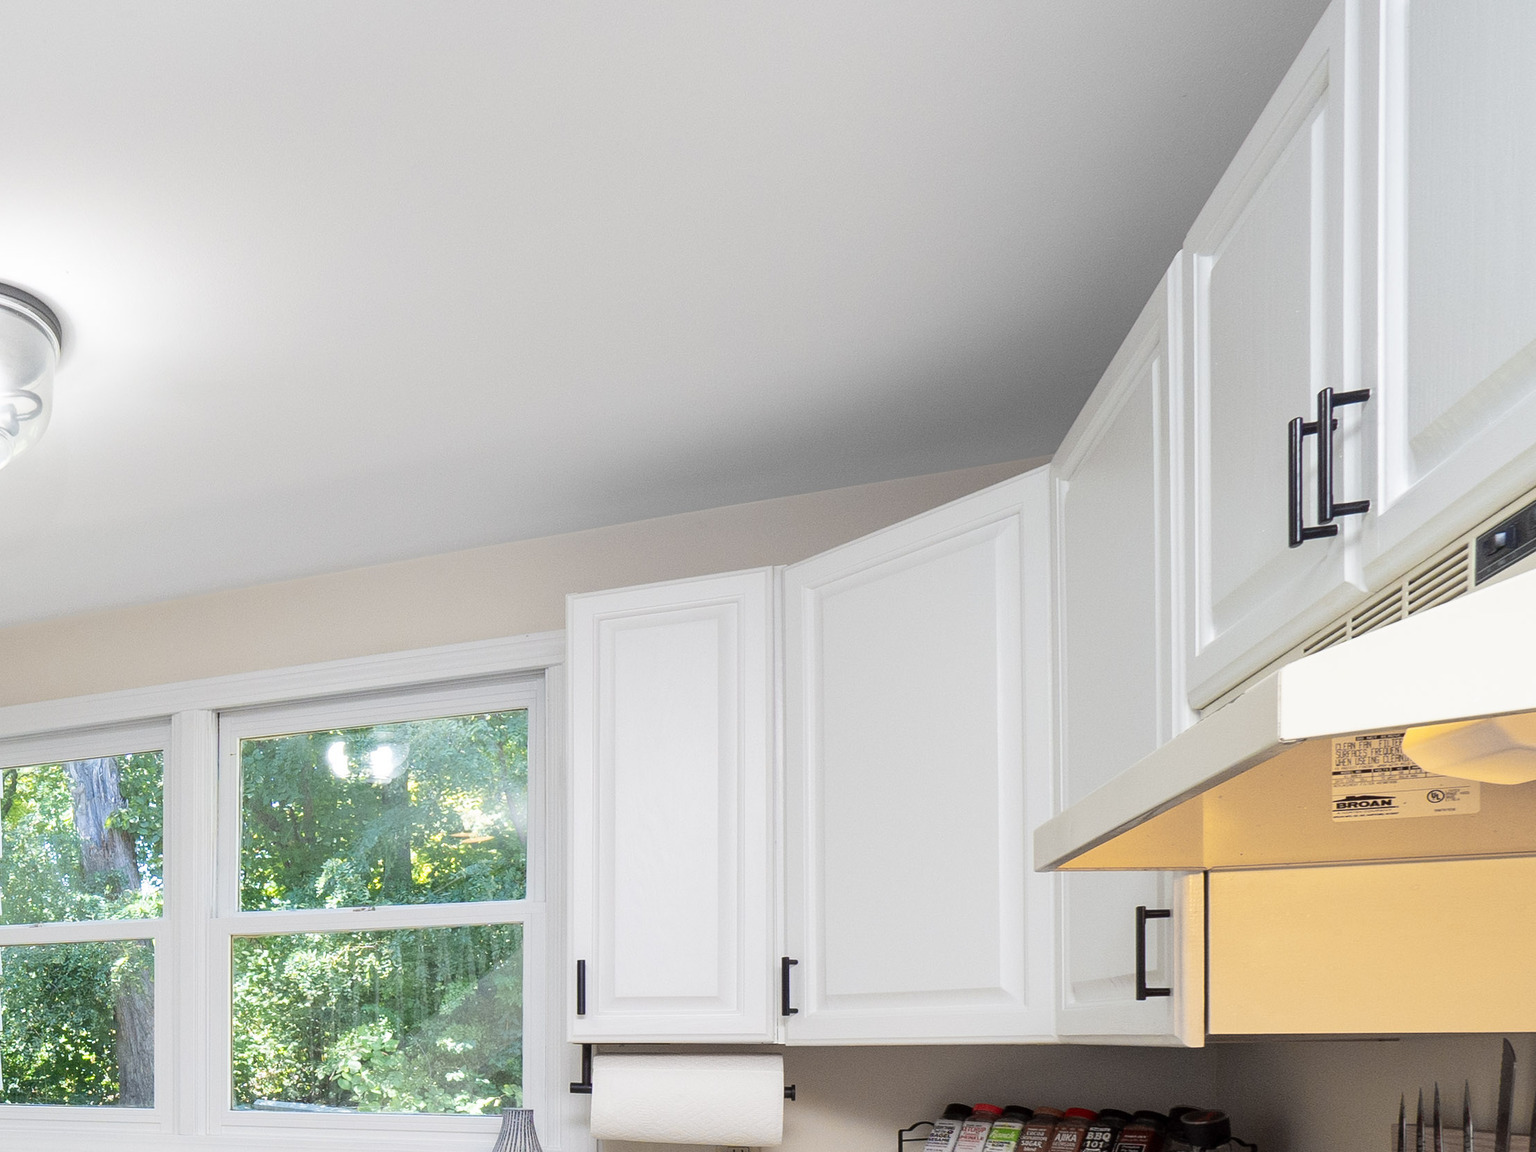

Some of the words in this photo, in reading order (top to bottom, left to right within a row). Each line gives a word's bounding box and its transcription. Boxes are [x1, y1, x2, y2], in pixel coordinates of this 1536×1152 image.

[1335, 742, 1355, 750] CLEAN
[1359, 740, 1372, 748] FAN
[1335, 749, 1368, 758] SURFACES
[1336, 799, 1392, 809] BROAN
[1054, 1133, 1077, 1142] AJIKA
[1086, 1132, 1111, 1142] BBQ
[1021, 1140, 1043, 1148] SUGAR
